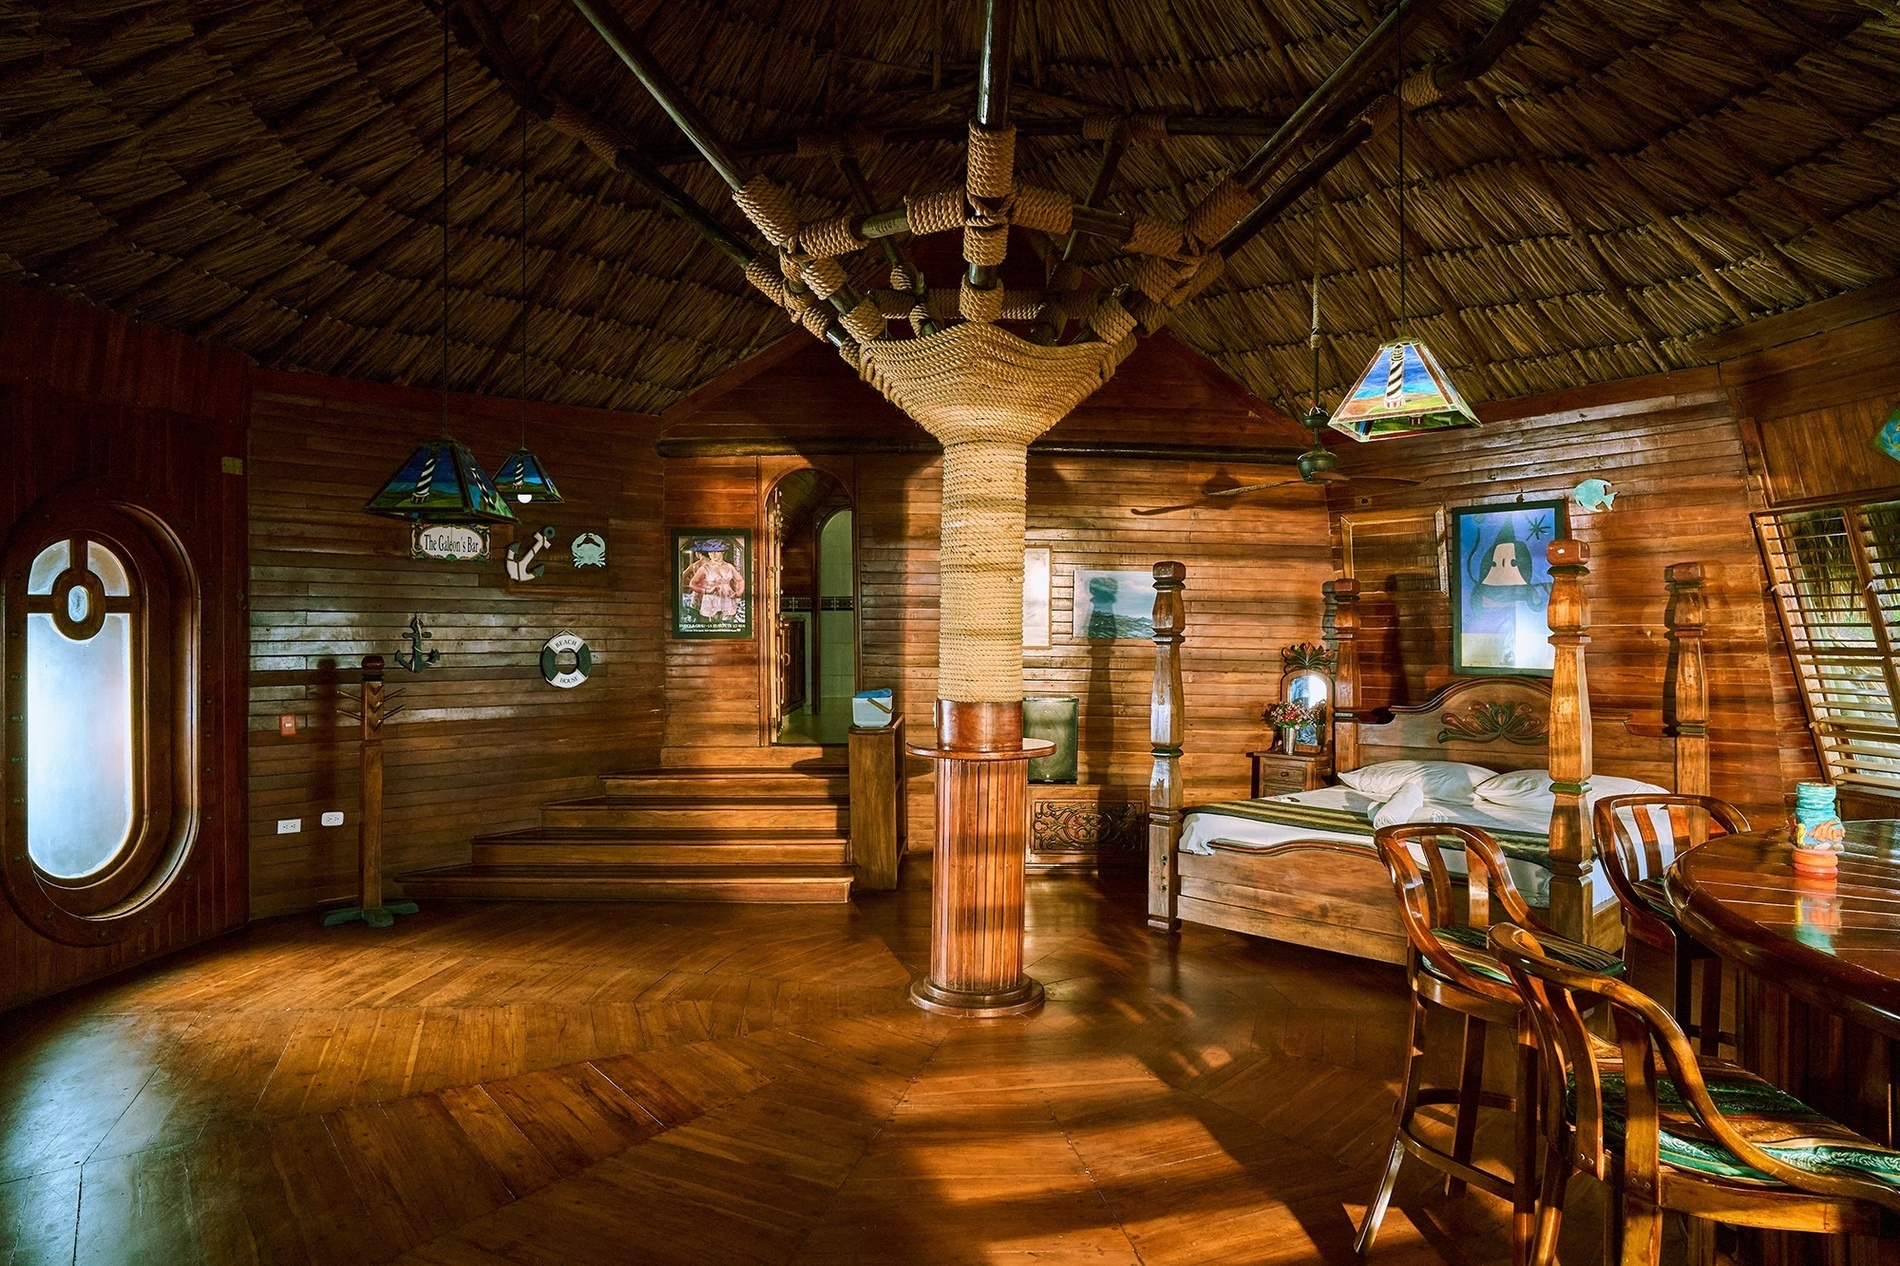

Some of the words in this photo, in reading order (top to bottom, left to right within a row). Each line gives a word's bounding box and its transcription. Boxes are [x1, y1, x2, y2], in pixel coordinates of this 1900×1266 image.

[424, 534, 437, 550] The
[467, 537, 478, 552] Bar
[555, 639, 577, 648] BEACH
